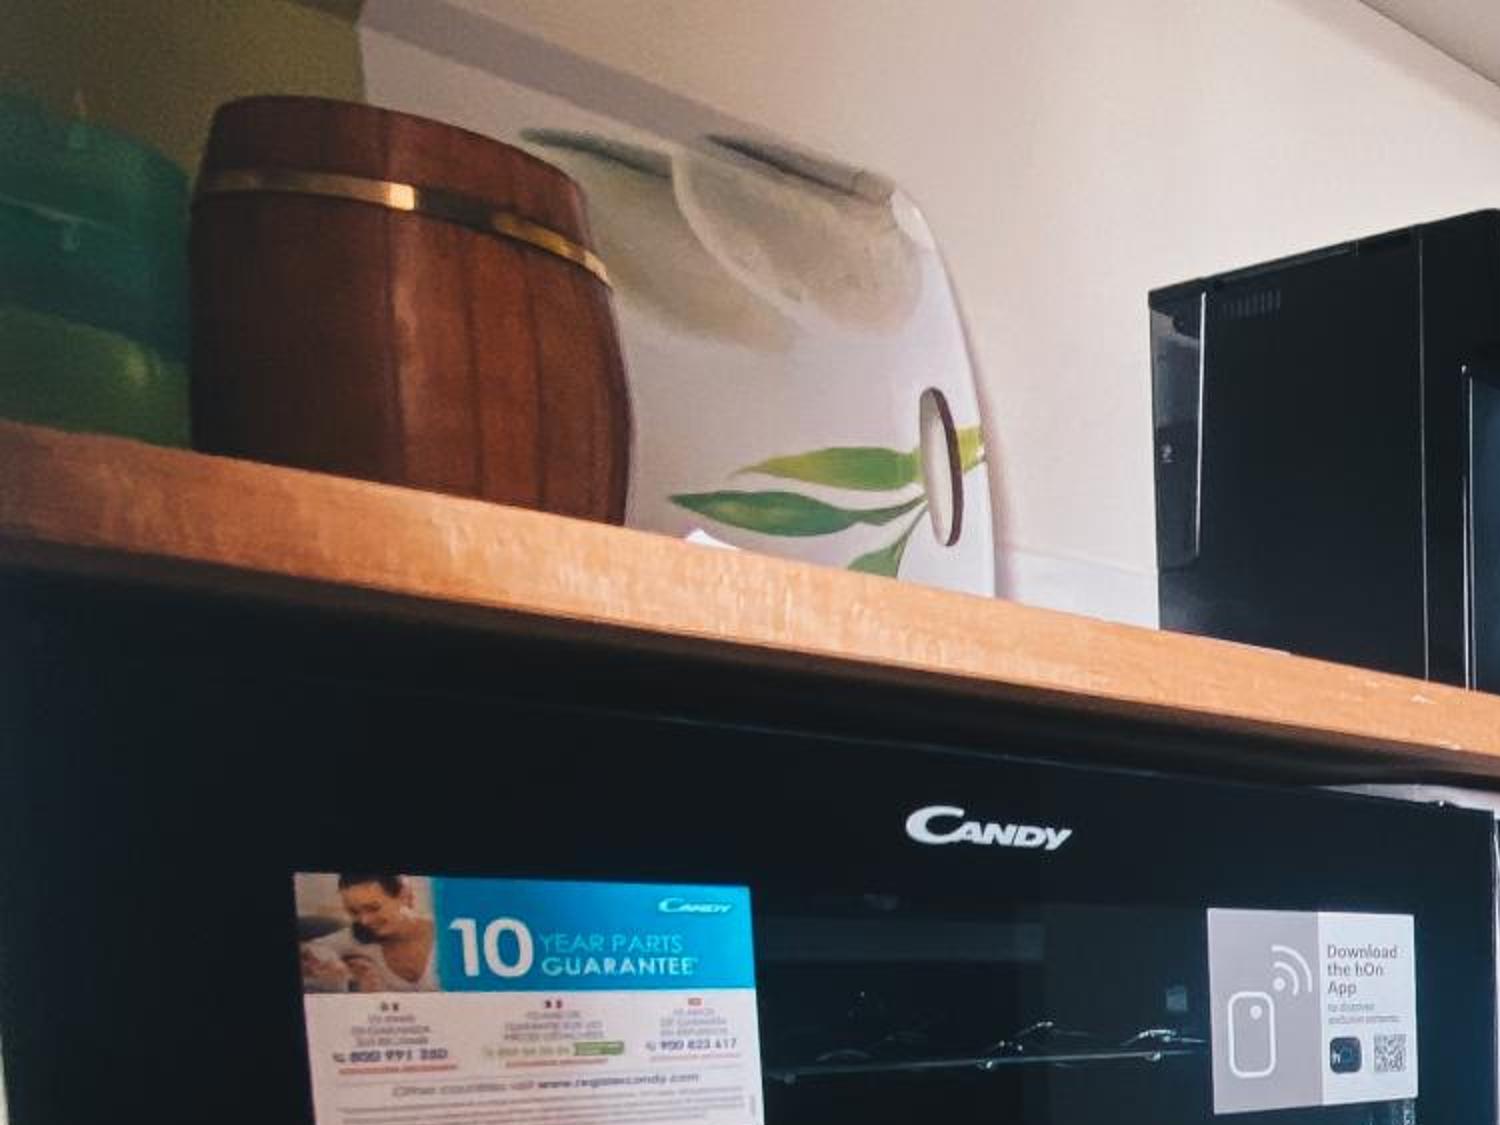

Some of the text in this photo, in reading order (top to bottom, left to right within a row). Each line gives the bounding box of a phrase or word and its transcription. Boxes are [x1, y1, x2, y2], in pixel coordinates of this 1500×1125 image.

[906, 805, 1072, 850] CANDY
[449, 917, 535, 979] 10
[540, 933, 684, 954] YEAR PARTS
[1327, 944, 1398, 959] Download
[1327, 962, 1351, 977] the
[1328, 981, 1358, 999] App
